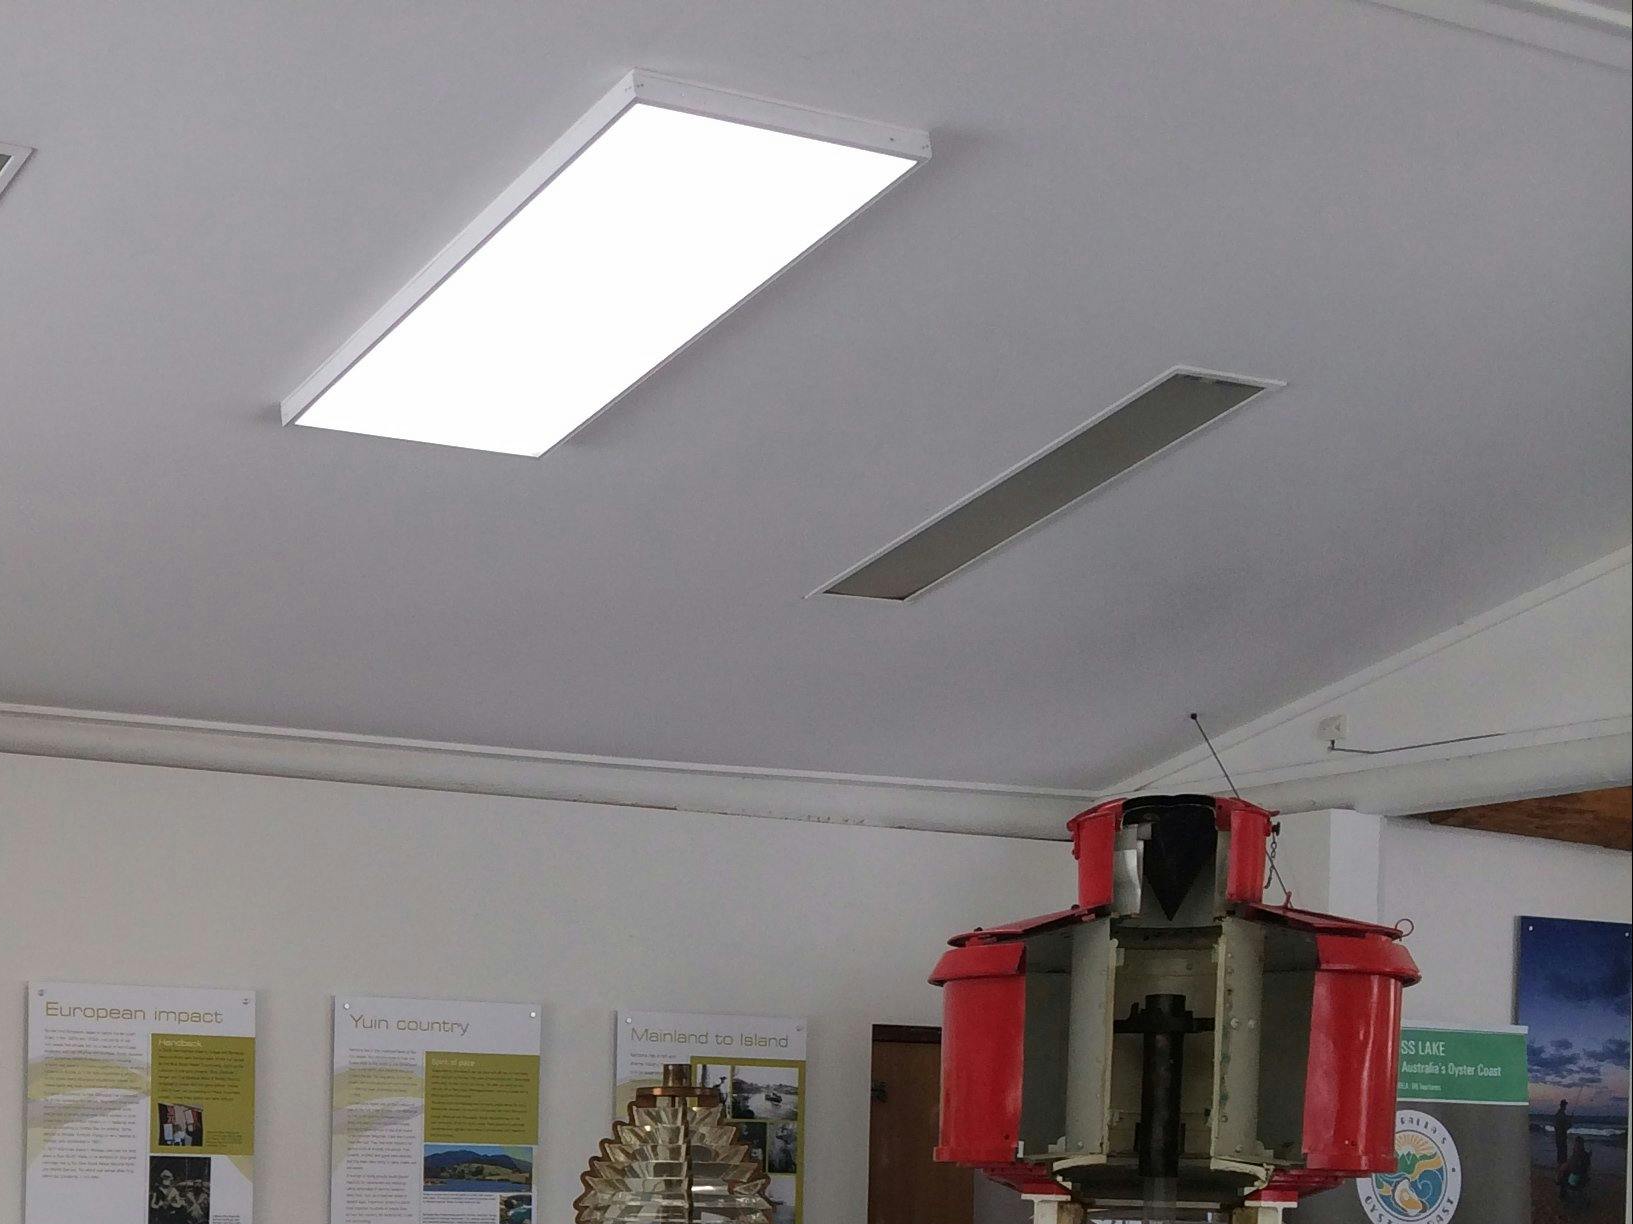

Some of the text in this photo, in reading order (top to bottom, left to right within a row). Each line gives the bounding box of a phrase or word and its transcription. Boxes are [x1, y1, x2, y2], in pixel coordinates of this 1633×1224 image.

[45, 1001, 224, 1024] European impact
[350, 1013, 470, 1036] Yuin country
[630, 1027, 788, 1048] Mainland to Island
[1418, 1041, 1446, 1057] LAKE
[1401, 1061, 1502, 1078] Australia's Oyster Coast
